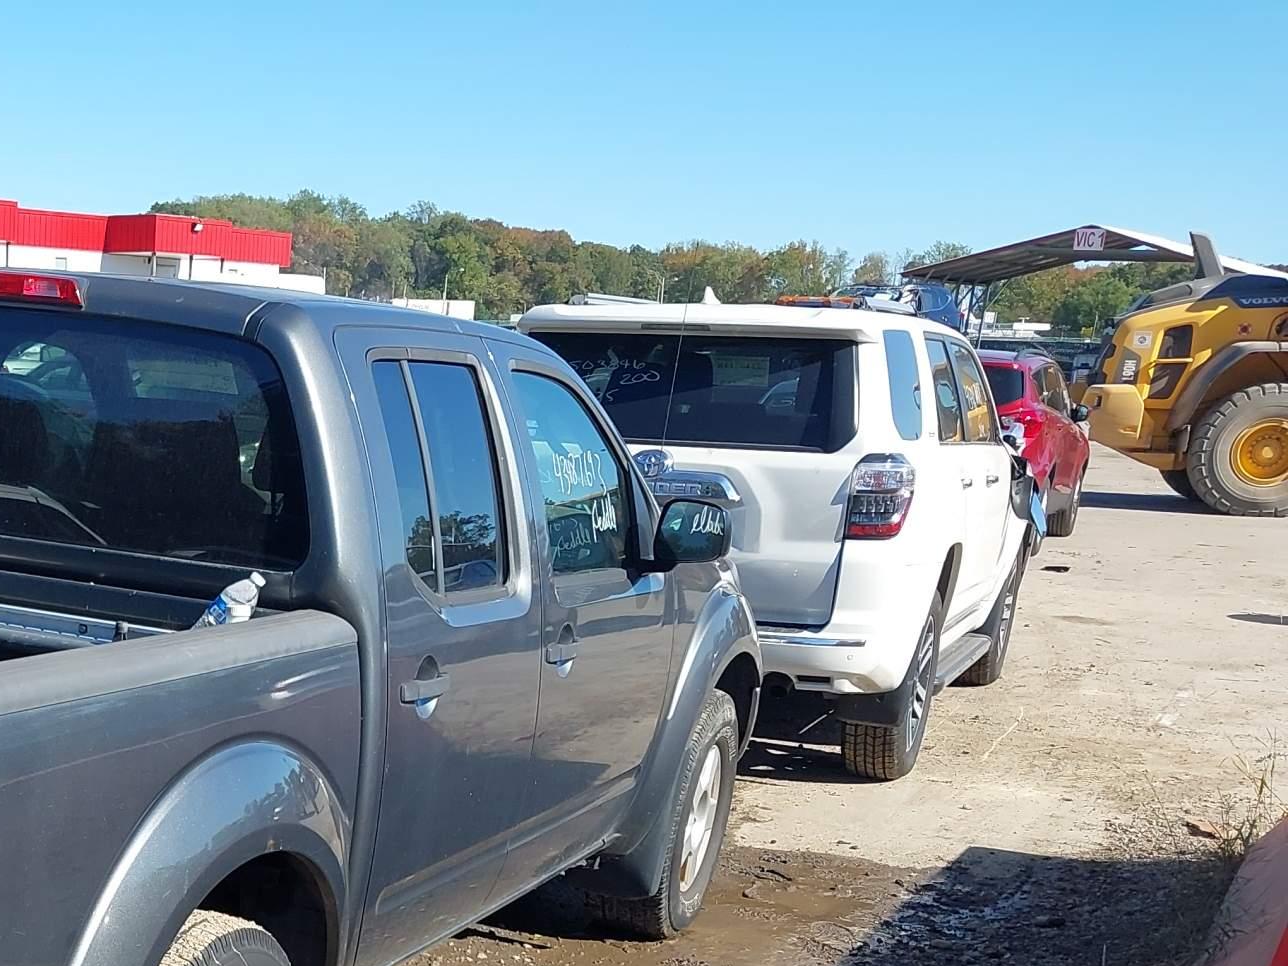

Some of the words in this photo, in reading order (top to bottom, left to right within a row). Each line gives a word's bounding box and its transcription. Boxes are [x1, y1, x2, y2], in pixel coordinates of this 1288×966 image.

[1076, 231, 1096, 247] VIC
[1098, 231, 1105, 246] 1
[1239, 296, 1288, 306] VOLVO
[1121, 359, 1138, 381] L90H
